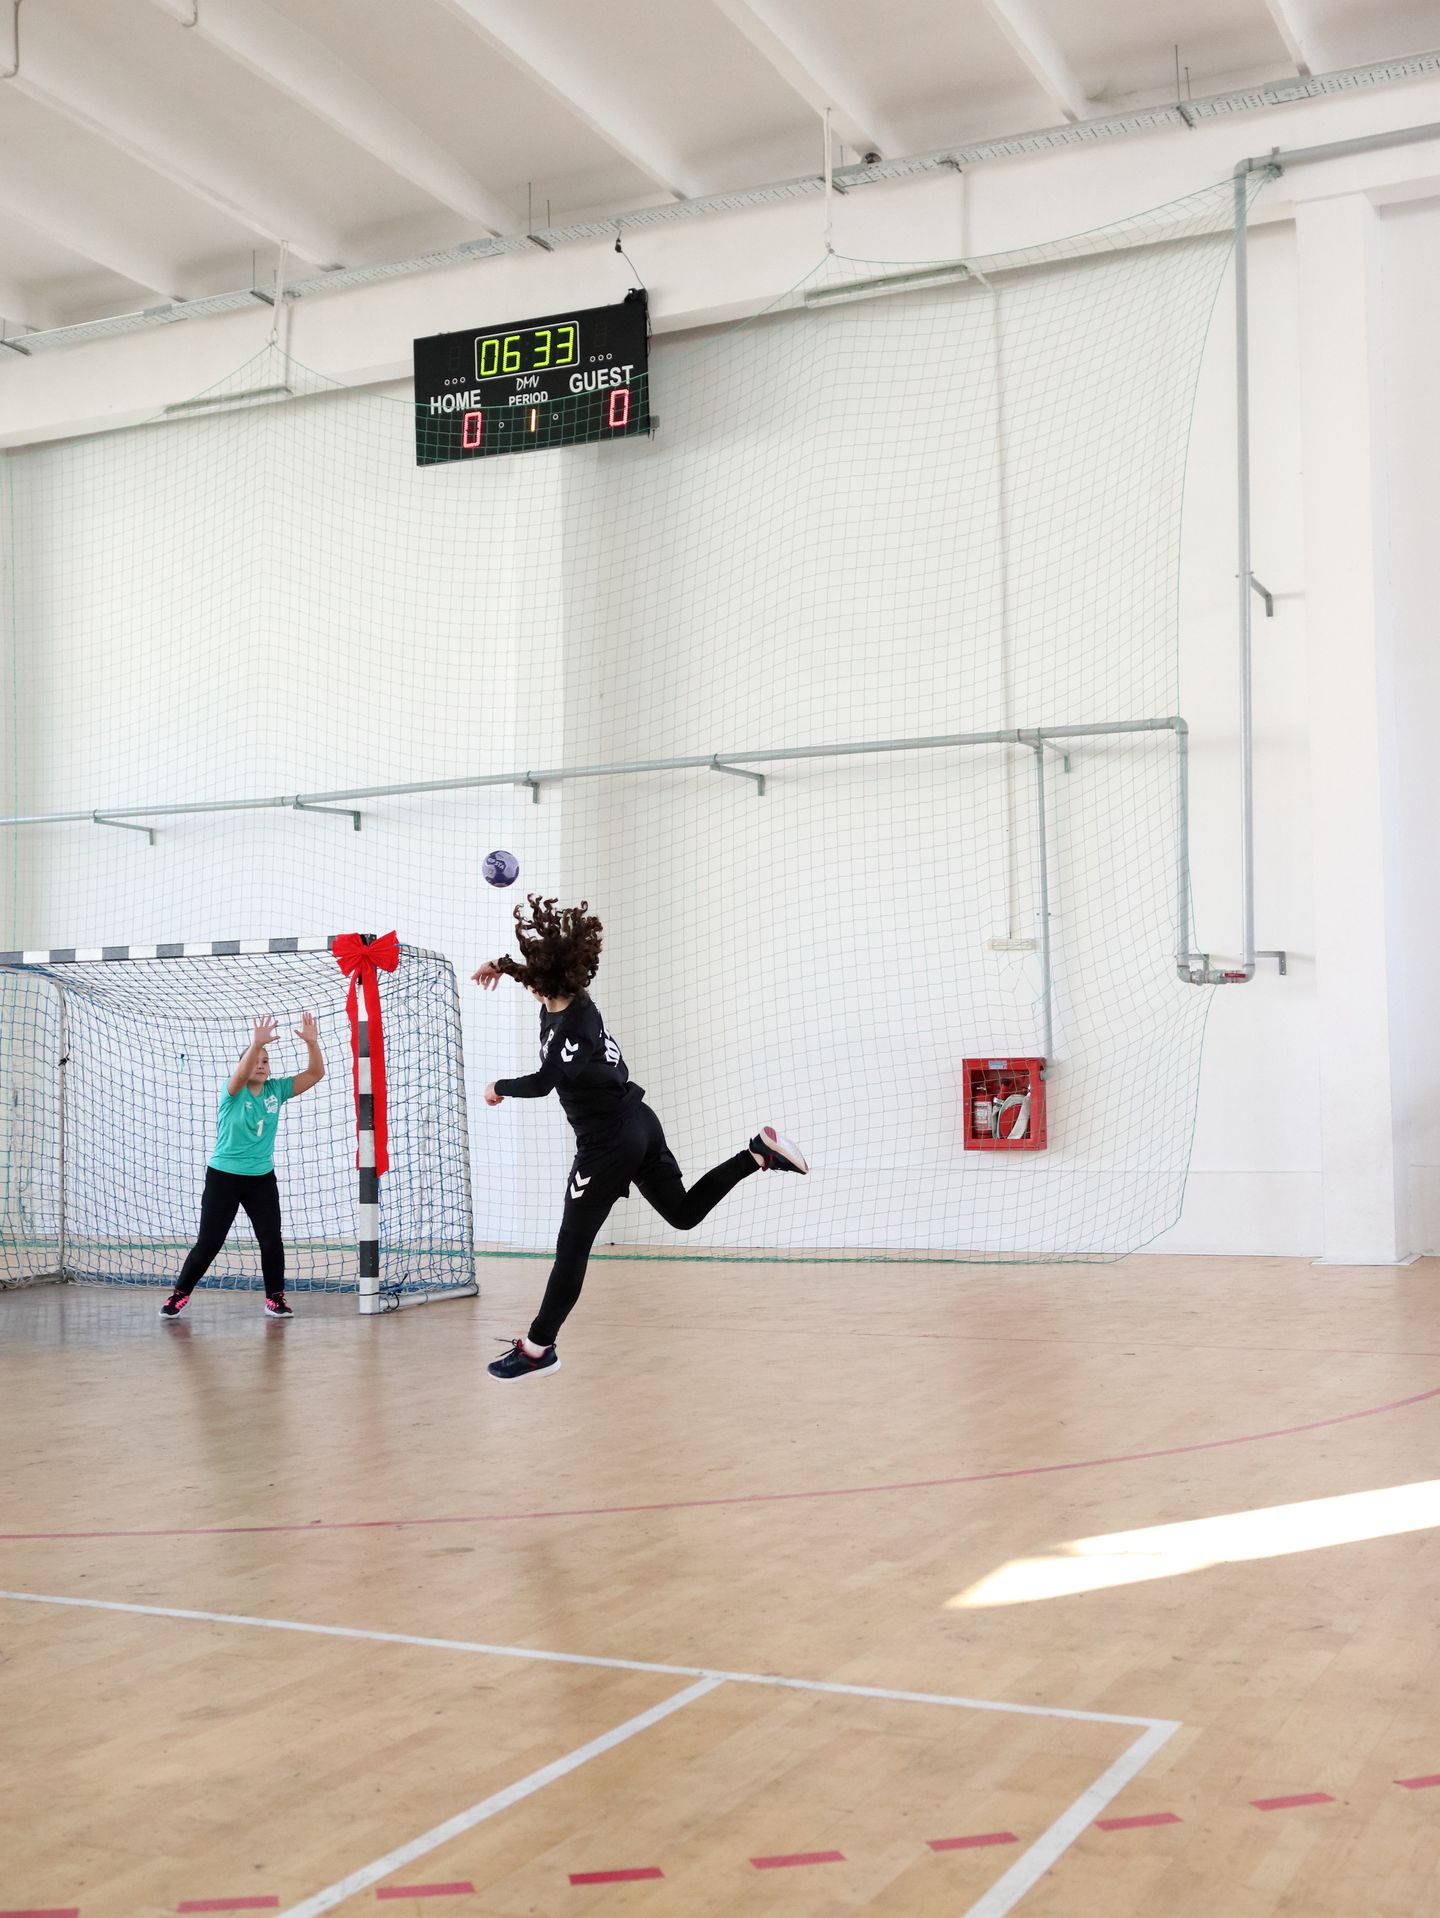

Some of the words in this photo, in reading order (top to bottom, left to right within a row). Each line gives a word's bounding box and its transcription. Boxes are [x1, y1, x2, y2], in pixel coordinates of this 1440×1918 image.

[516, 374, 540, 391] DMV
[569, 364, 634, 393] GUEST
[430, 389, 481, 415] HOME
[508, 390, 549, 406] PERIOD
[609, 388, 629, 427] 0
[463, 411, 482, 449] 0
[530, 408, 537, 432] 1
[256, 1119, 264, 1137] 1
